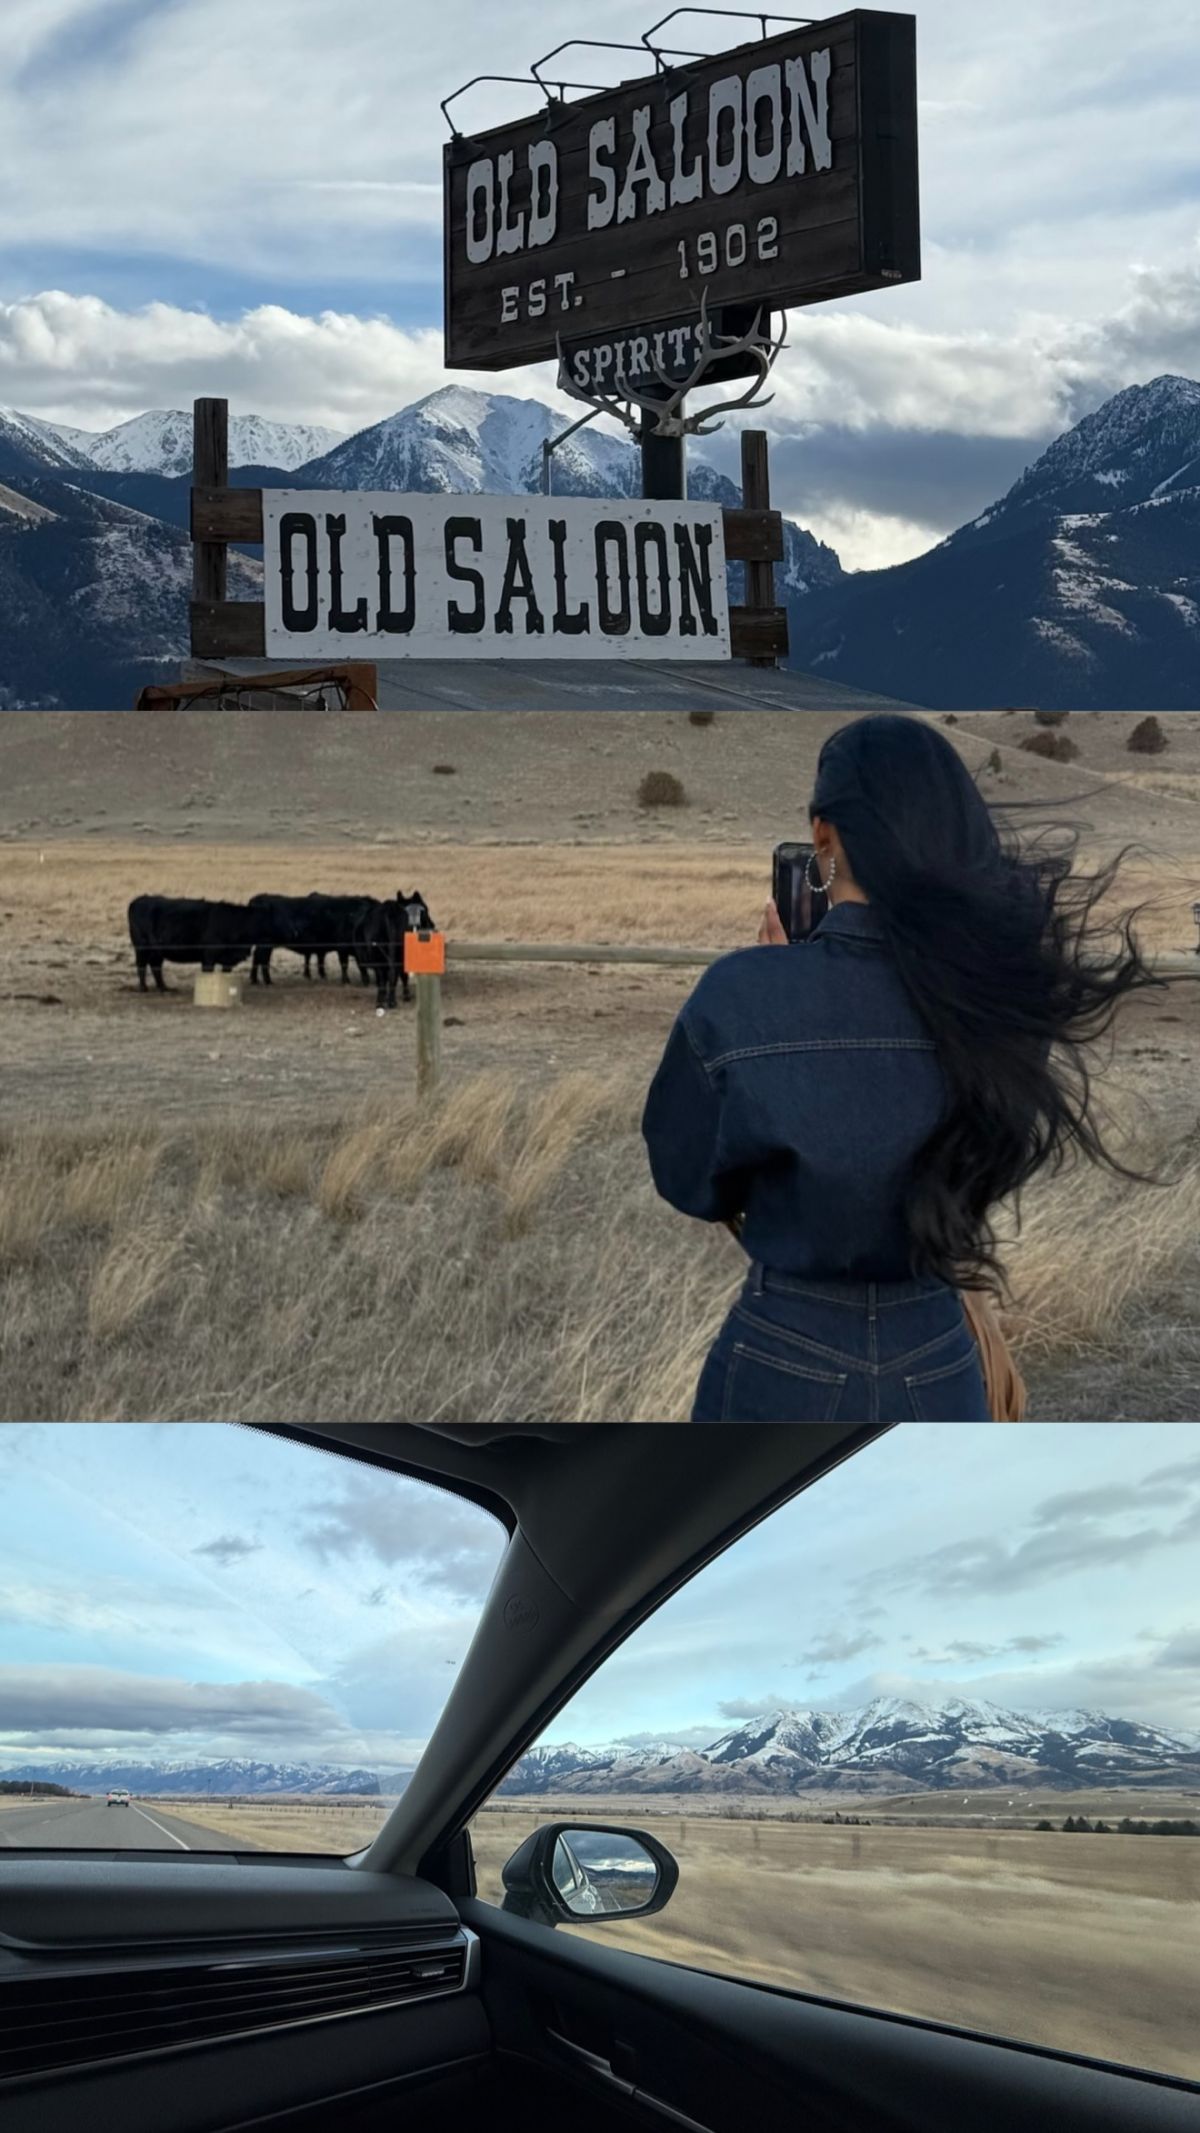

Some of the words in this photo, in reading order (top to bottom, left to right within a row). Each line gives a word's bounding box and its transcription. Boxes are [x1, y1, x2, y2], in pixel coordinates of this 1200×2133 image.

[465, 139, 559, 264] OLD
[587, 47, 832, 231] SALOON
[501, 271, 583, 323] EST.
[677, 216, 779, 279] 1902
[279, 512, 417, 634] OLD
[444, 516, 720, 637] SALOON
